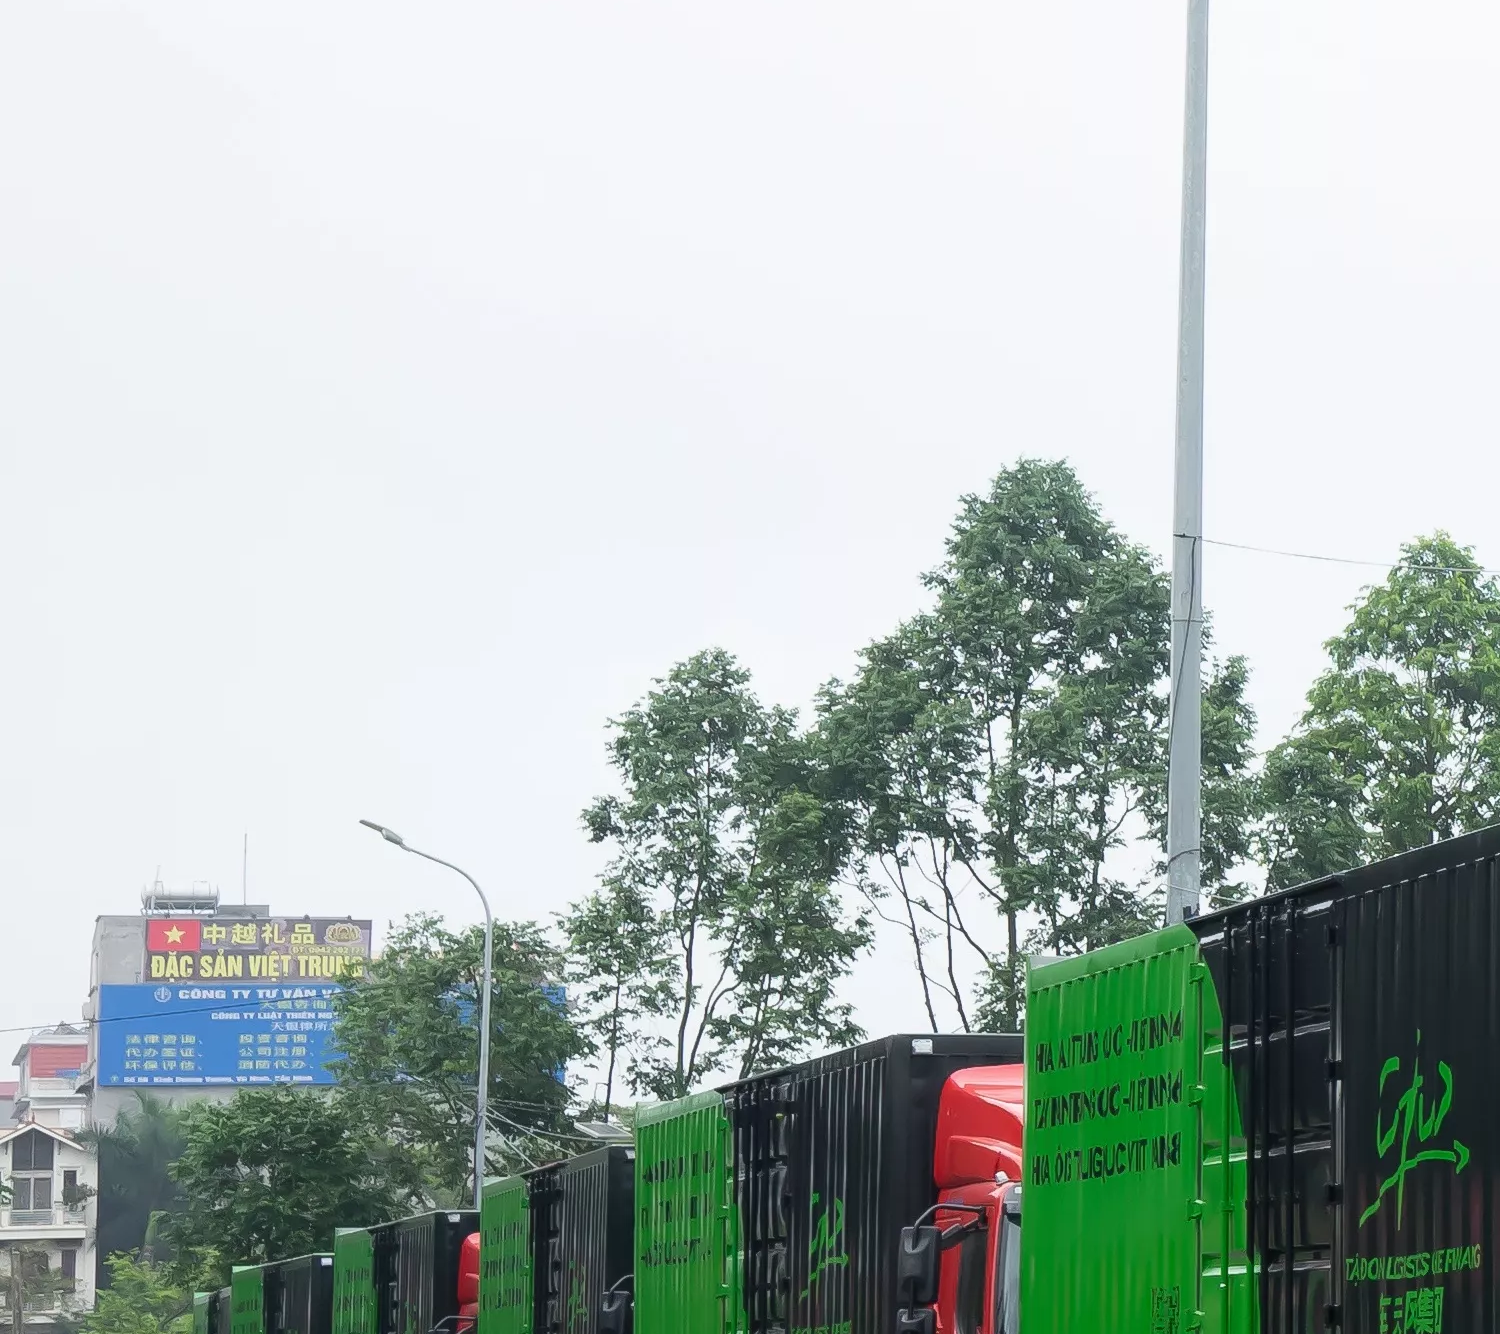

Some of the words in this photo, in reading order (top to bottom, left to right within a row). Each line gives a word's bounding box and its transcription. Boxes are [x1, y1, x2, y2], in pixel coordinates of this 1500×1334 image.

[203, 923, 315, 945] 中越礼品
[151, 951, 193, 982] ĐẶC
[200, 948, 242, 977] SẢN
[249, 951, 291, 982] VIỆT
[298, 955, 363, 978] TRUNG
[178, 988, 226, 1000] CÔNG
[232, 989, 252, 999] TY
[258, 1011, 282, 1021] LUẬT
